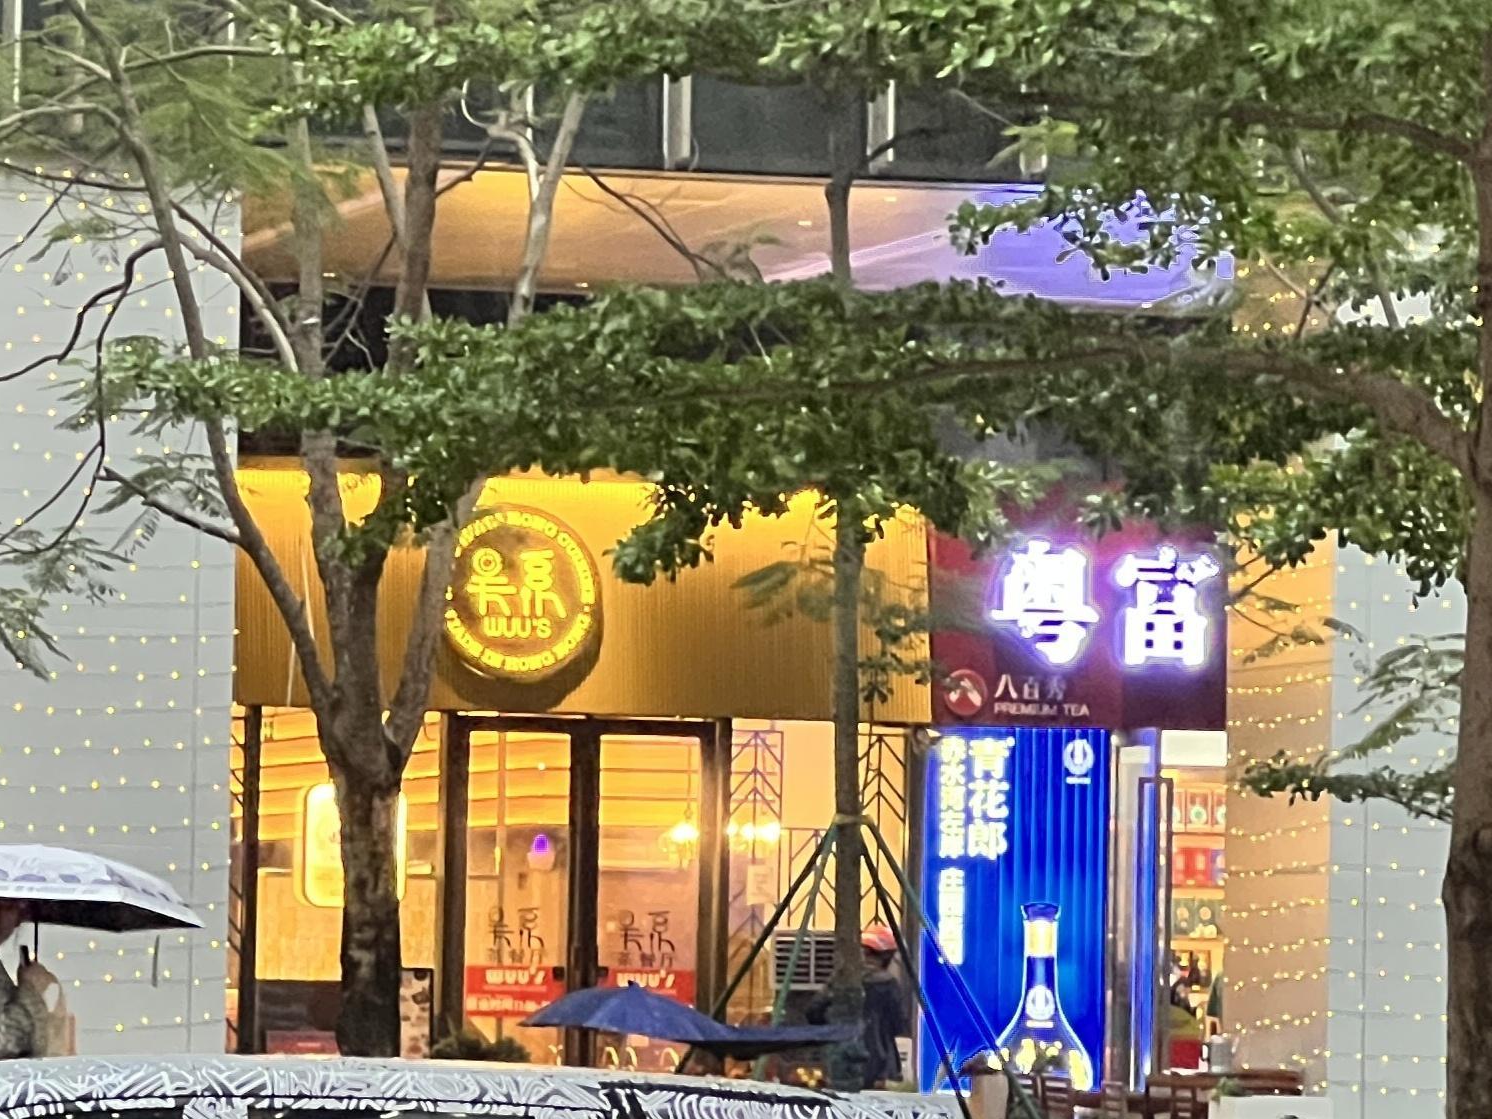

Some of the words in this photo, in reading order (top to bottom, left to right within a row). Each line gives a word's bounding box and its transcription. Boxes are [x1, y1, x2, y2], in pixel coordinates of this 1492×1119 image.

[1063, 703, 1090, 717] TEA
[968, 737, 1015, 861] 青花郎
